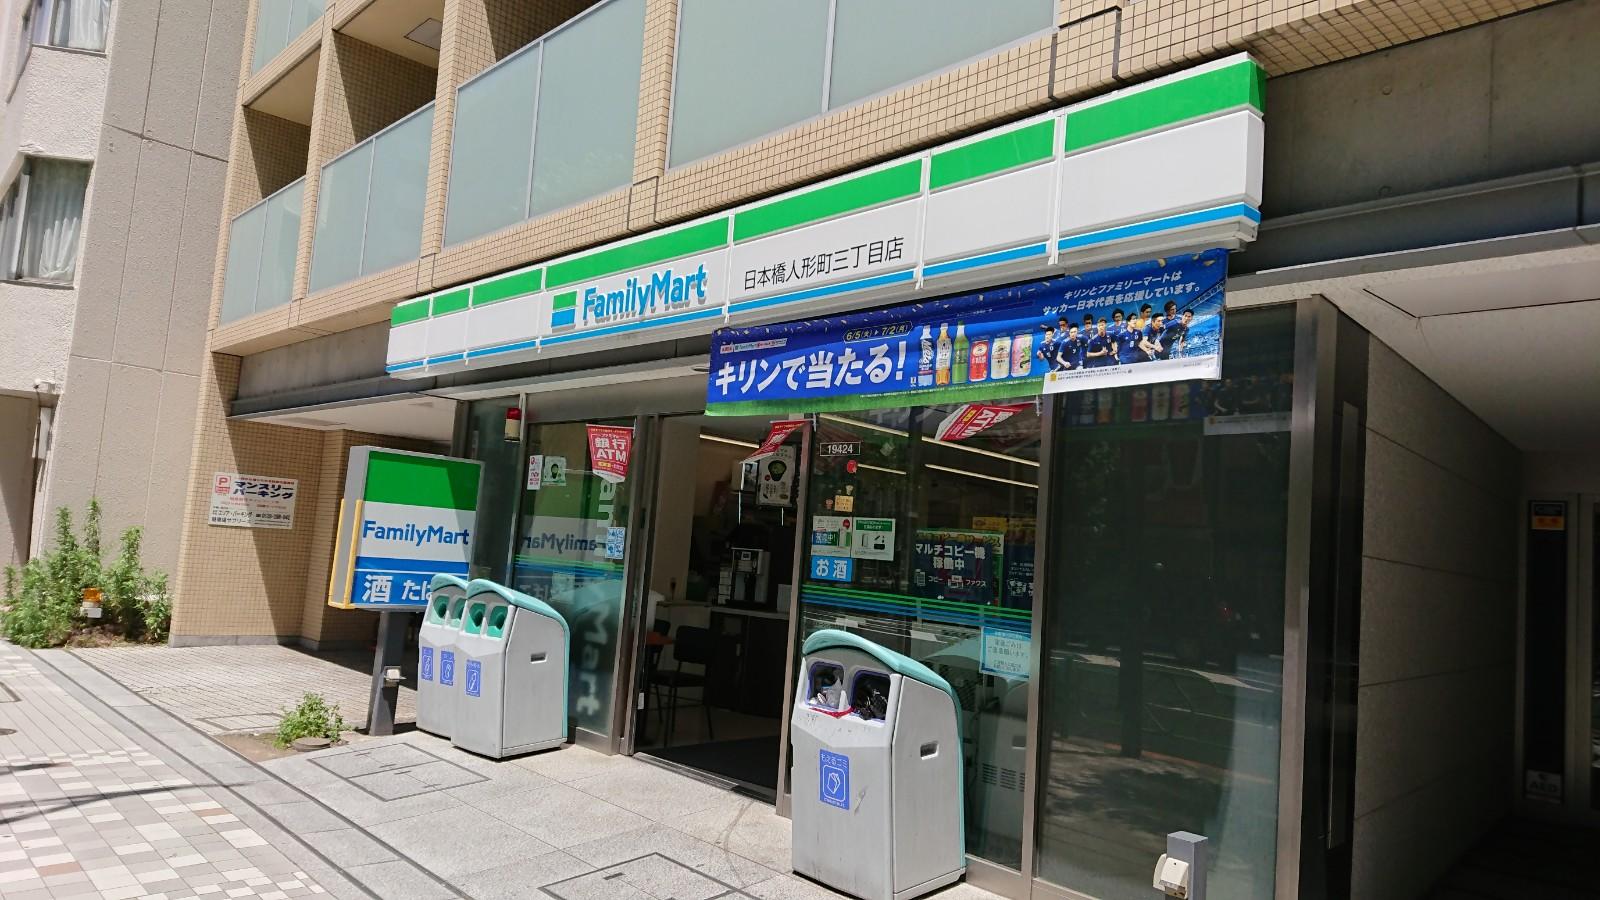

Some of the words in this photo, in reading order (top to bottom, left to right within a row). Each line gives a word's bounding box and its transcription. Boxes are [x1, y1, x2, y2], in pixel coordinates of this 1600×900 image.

[744, 237, 904, 290] 日本橋人形町三丁目店
[583, 264, 707, 321] FamilyMart
[1064, 270, 1182, 299] キリンとファミリーマートは
[1043, 282, 1200, 315] サッカー日本代表を応援しています。
[594, 437, 627, 450] 銀行
[827, 443, 854, 454] 19424
[596, 449, 627, 463] ATM
[218, 477, 228, 486] P
[234, 481, 294, 491] マンスリー
[232, 488, 294, 499] パーキング
[363, 520, 469, 546] FamilyMart
[915, 543, 986, 559] マルチコピー機
[815, 558, 848, 579] お酒
[928, 575, 943, 583] コピー
[362, 574, 394, 603] 酒
